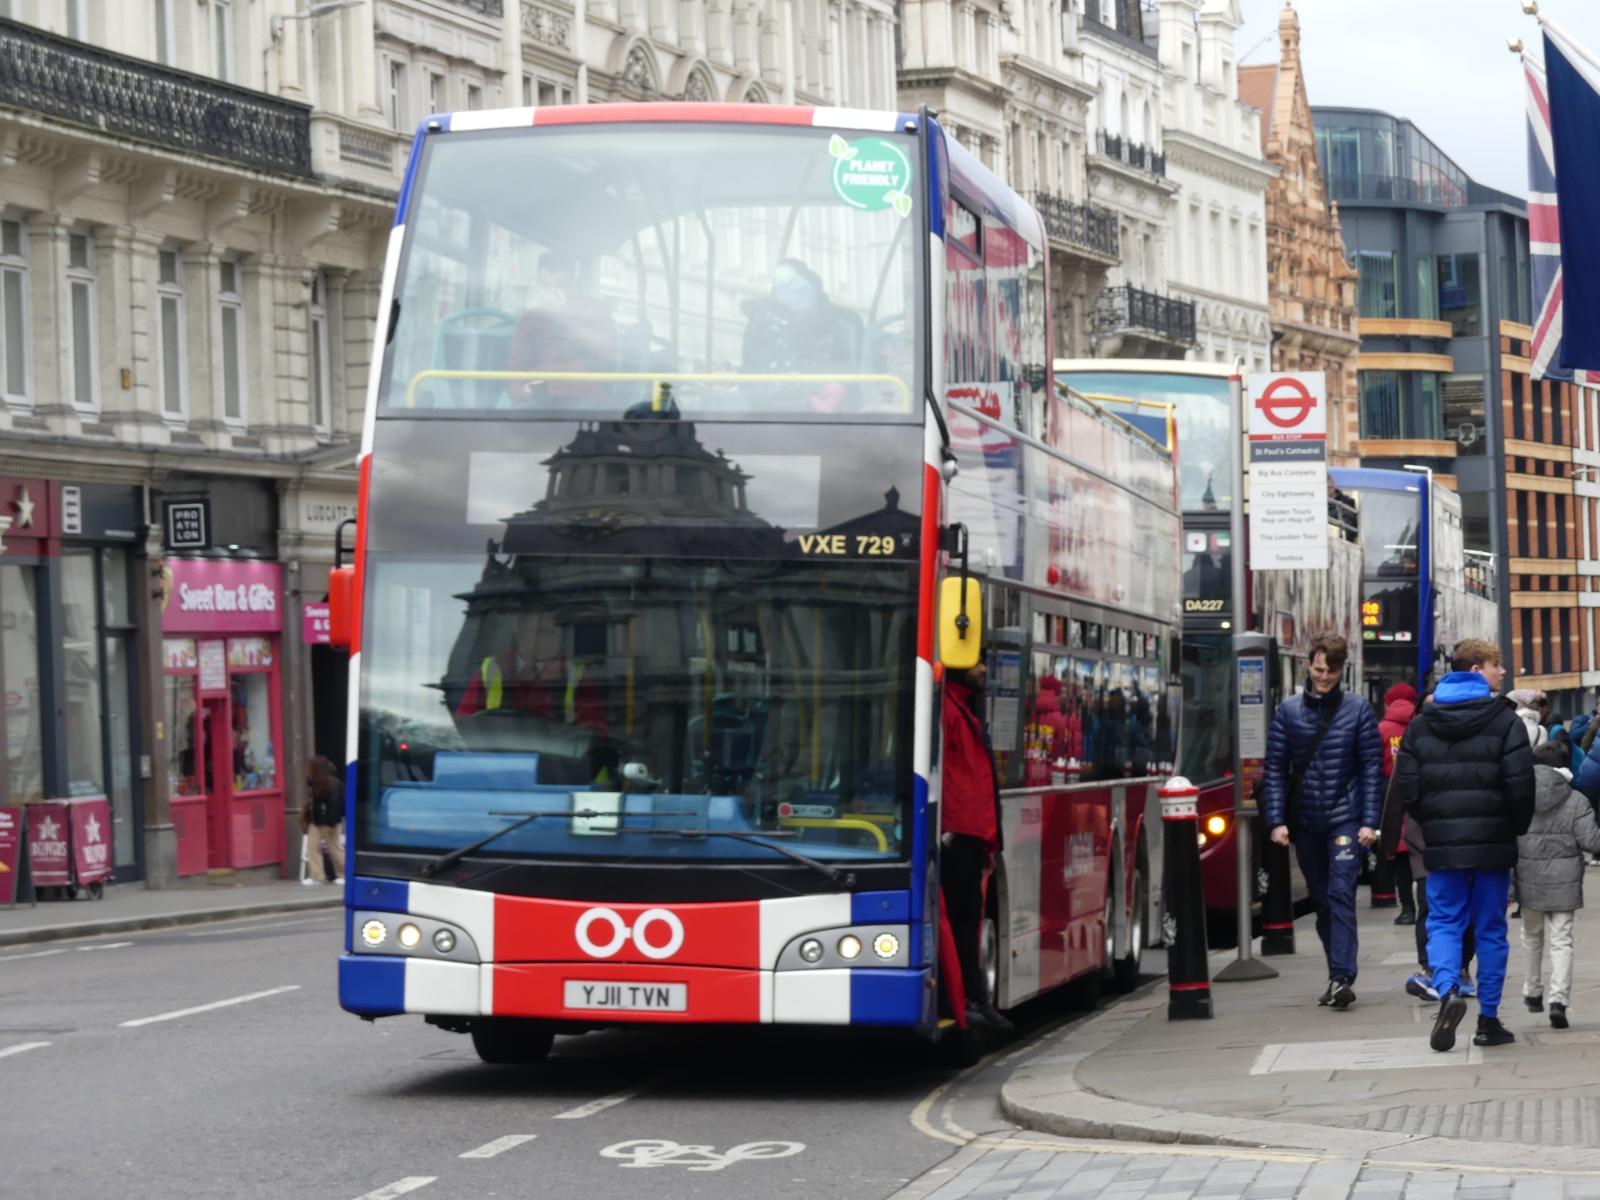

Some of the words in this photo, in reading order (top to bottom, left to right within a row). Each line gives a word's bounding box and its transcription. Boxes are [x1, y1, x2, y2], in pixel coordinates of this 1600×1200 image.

[849, 160, 895, 172] PLANET
[842, 172, 900, 187] FRIENDLY
[1285, 447, 1321, 455] Cathedral
[1258, 469, 1269, 478] Big
[1284, 469, 1317, 477] Company
[1277, 490, 1315, 498] Sightseeing
[175, 510, 198, 520] PRO
[175, 521, 198, 530] ATH
[176, 530, 199, 540] LON
[798, 535, 847, 554] VXE
[856, 535, 895, 555] 729
[180, 582, 214, 612] Sweet
[215, 583, 237, 612] Box
[237, 584, 248, 612] &
[248, 583, 276, 612] Gifts
[1185, 599, 1225, 611] DA227
[583, 985, 622, 1006] YJ11
[628, 986, 670, 1007] TVN
